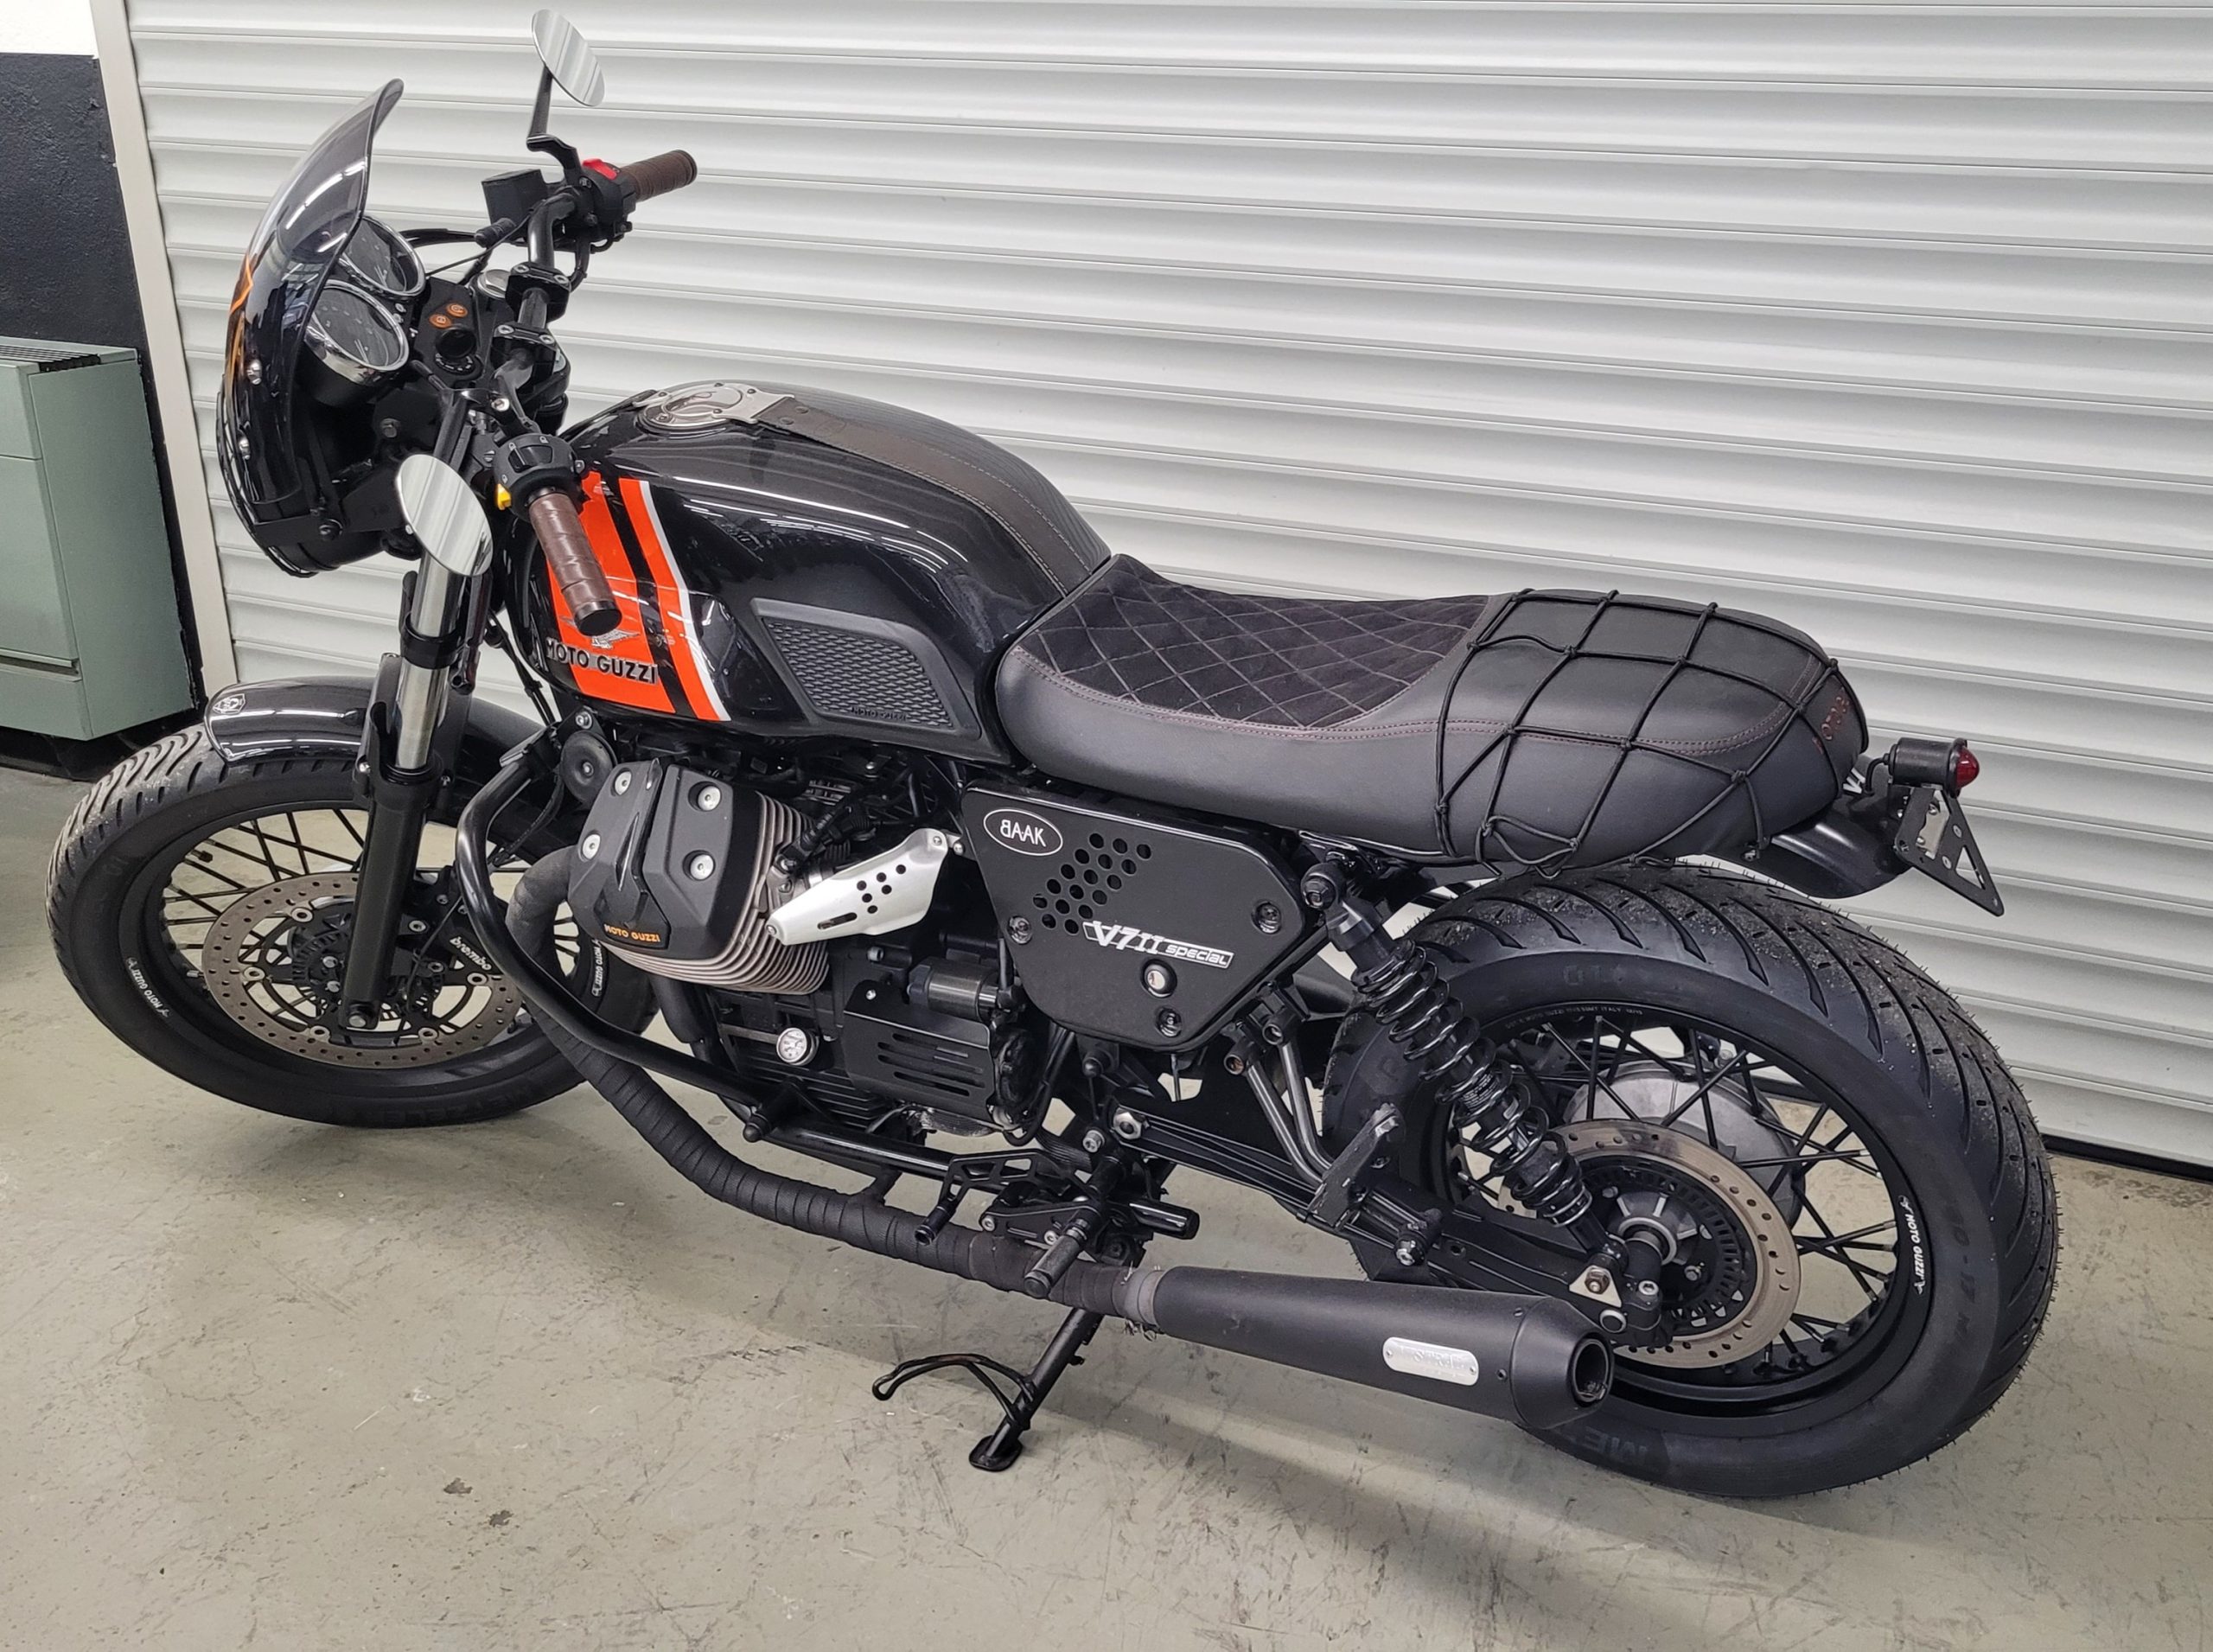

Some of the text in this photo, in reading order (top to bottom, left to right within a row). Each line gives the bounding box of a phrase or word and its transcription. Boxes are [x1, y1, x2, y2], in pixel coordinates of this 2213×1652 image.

[546, 638, 657, 684] MOTO GUZZI
[603, 923, 661, 942] MOTO GUZZI
[450, 936, 492, 971] brembo
[592, 946, 603, 965] MOTO
[131, 968, 163, 1009] MOTO GUZZI
[1904, 1214, 1925, 1277] MOTO GUZZI
